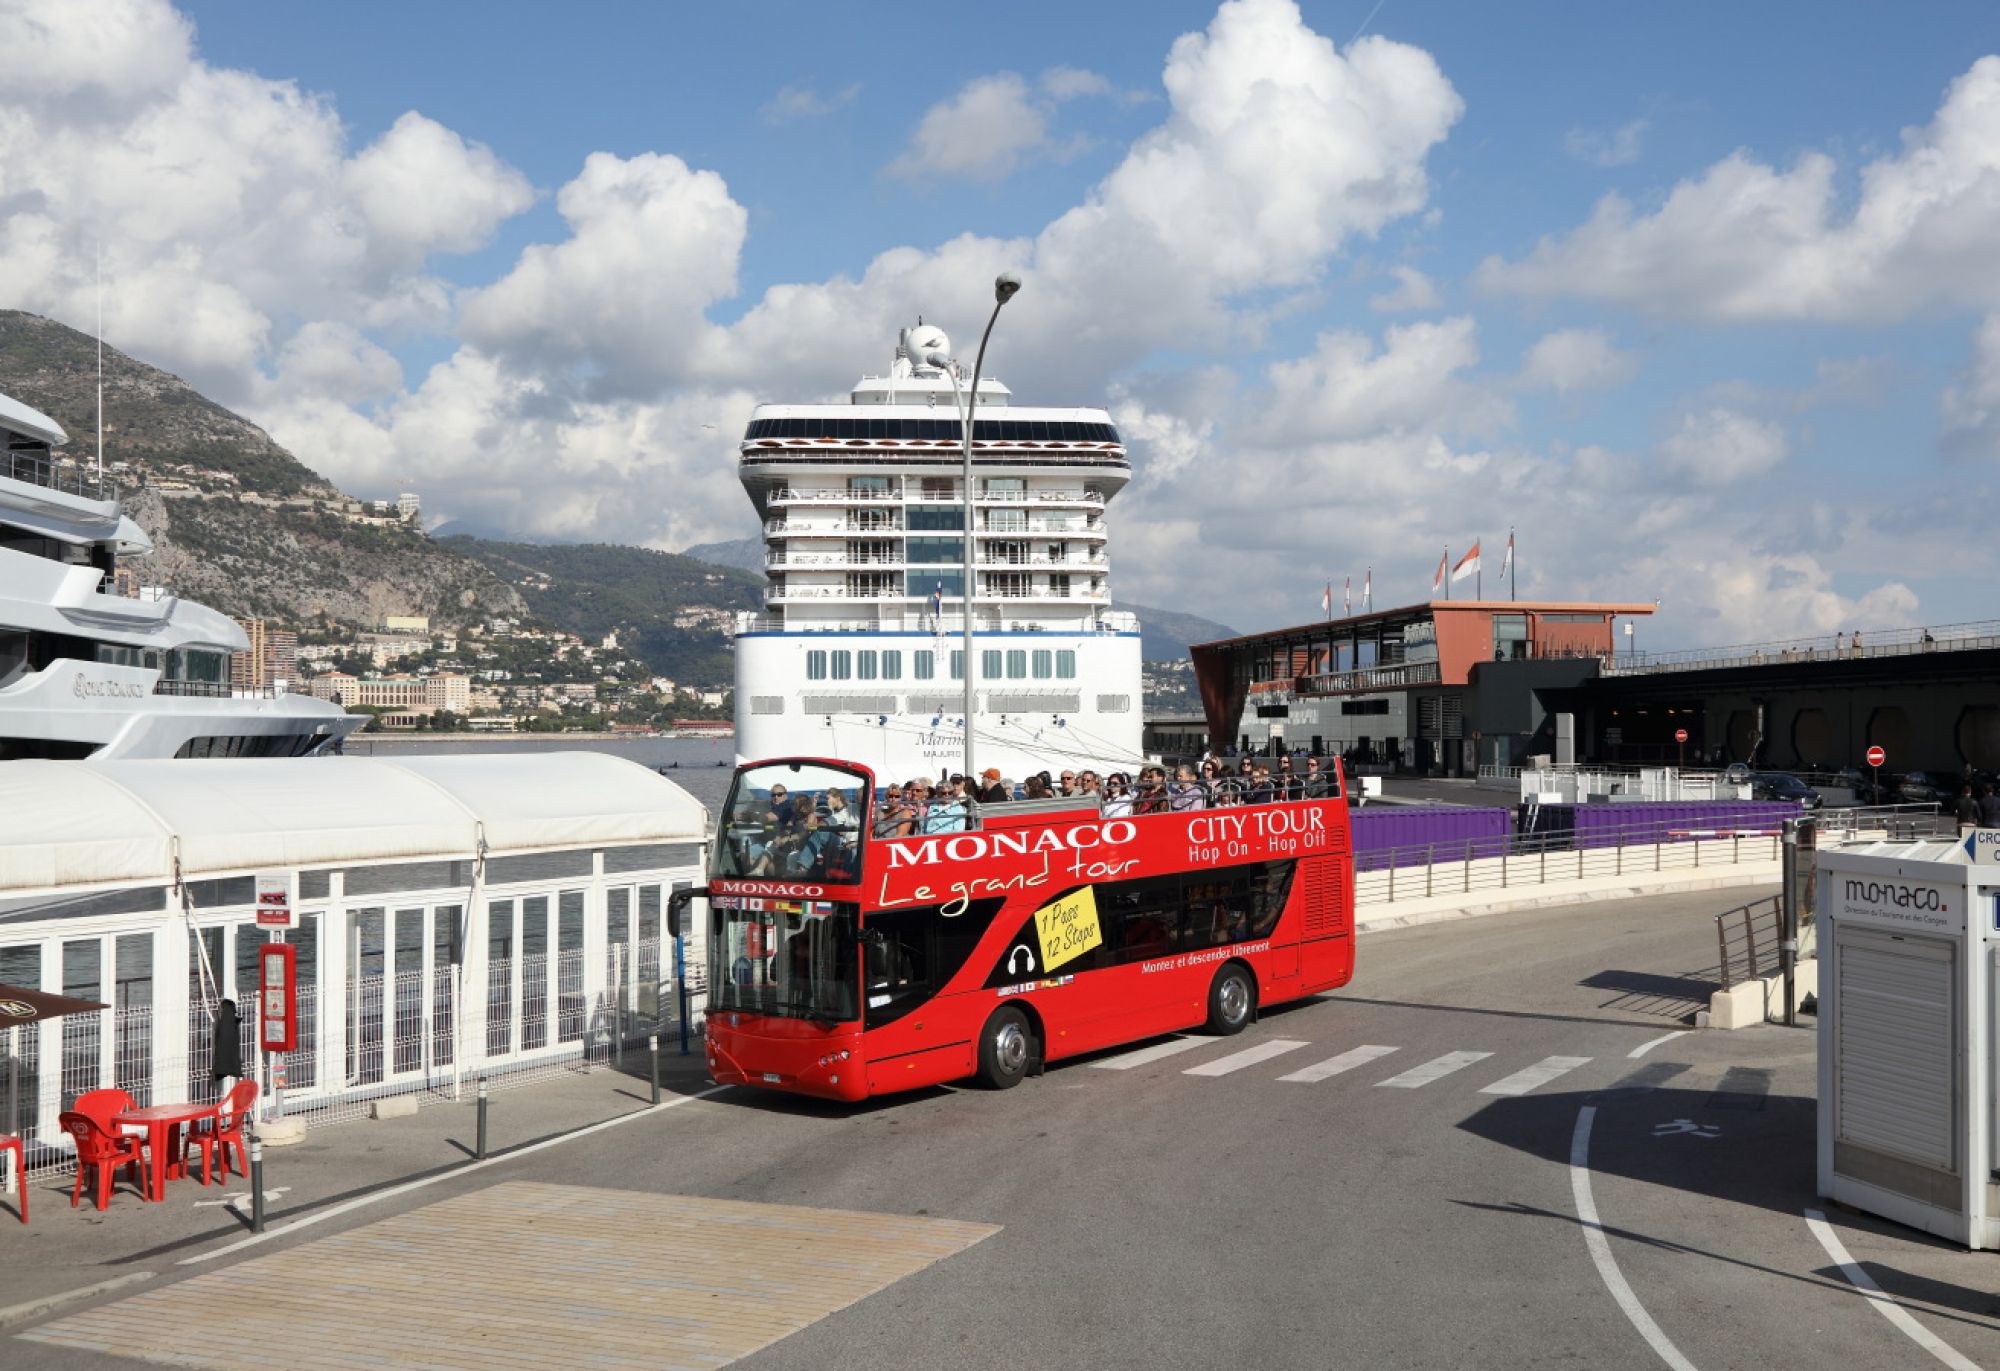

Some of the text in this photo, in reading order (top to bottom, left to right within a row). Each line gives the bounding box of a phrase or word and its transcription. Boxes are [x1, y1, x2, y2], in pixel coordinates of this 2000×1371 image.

[1188, 807, 1325, 843] CITY TOUR
[886, 820, 1137, 869] MONACO
[1189, 845, 1220, 865] Hop
[1228, 840, 1248, 857] On
[1269, 835, 1297, 855] Hop
[1304, 829, 1326, 848] Off
[723, 881, 824, 896] MONACO
[878, 845, 1141, 917] Le grand tour
[1042, 902, 1080, 935] 1 Pass
[1879, 908, 1904, 920] Tourisme
[1046, 922, 1096, 959] 12 Stops
[1142, 940, 1271, 974] Montez et descendez librement
